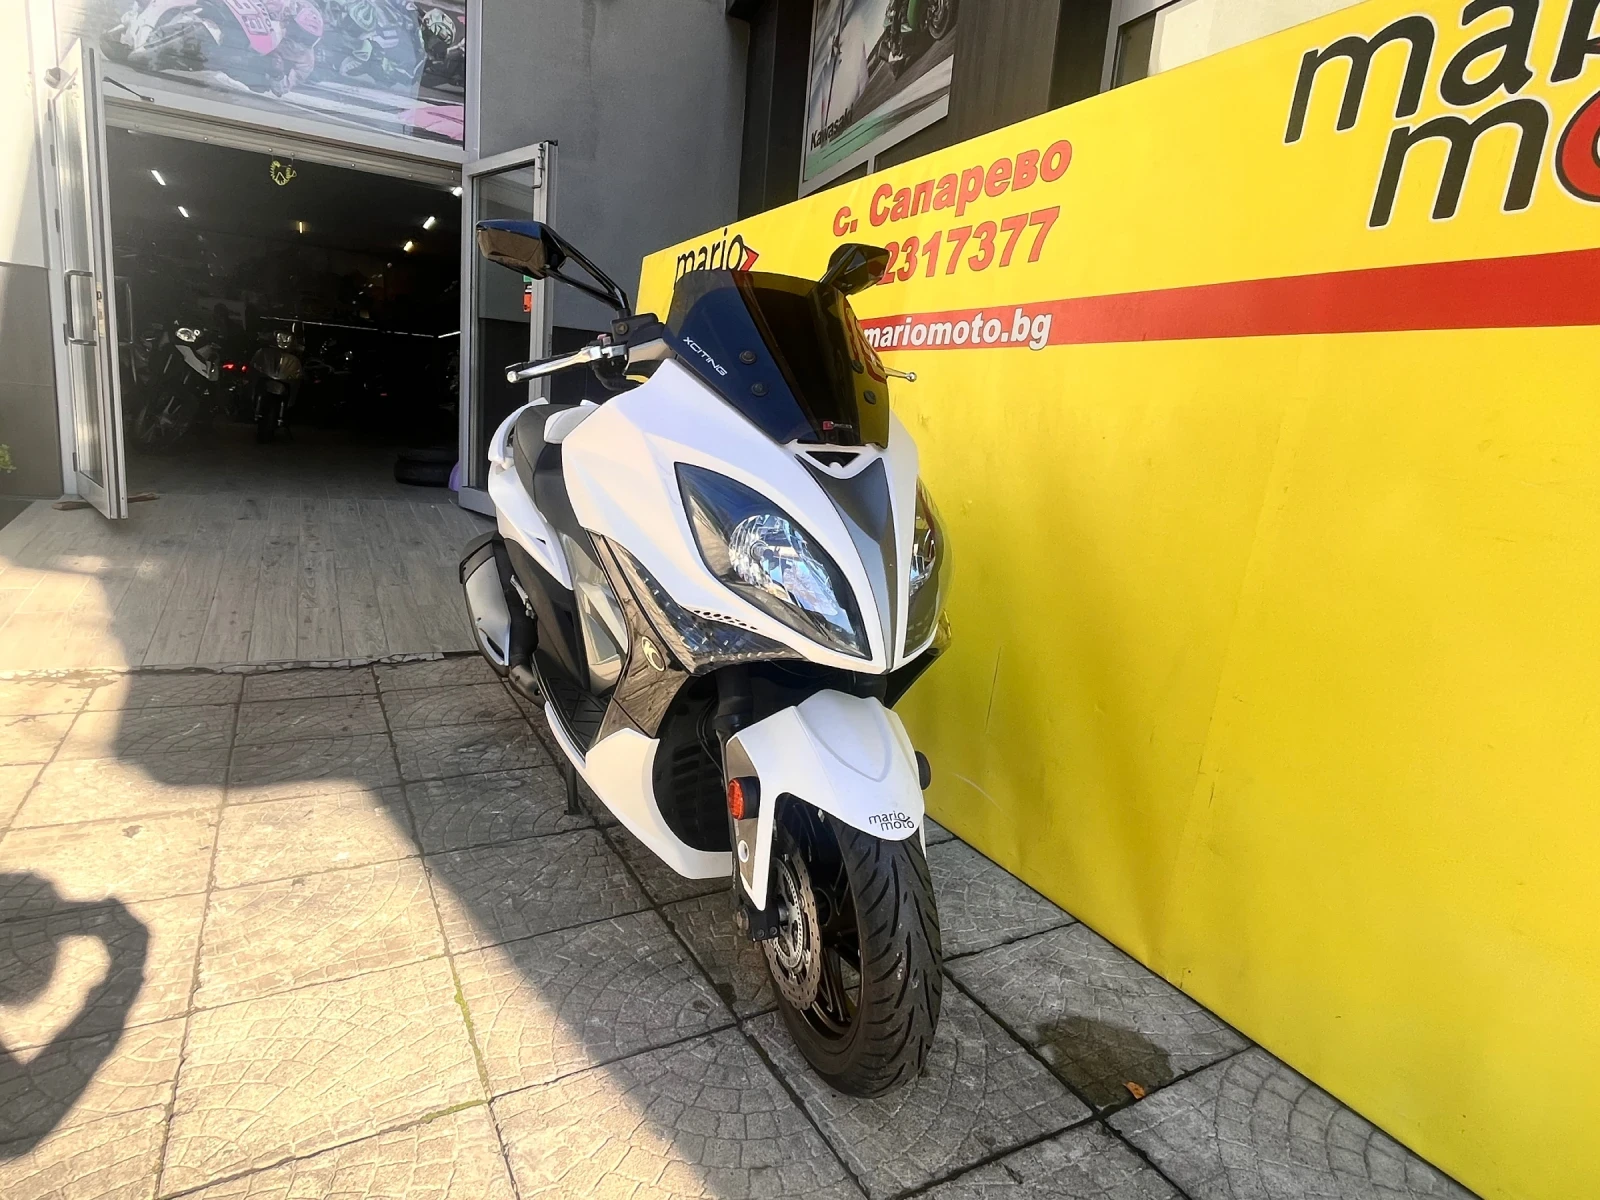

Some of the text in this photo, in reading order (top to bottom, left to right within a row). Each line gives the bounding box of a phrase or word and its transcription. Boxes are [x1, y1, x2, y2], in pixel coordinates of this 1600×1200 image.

[833, 139, 1073, 236] с. Сапарево
[675, 227, 744, 281] mario
[876, 205, 1060, 286] 2317377
[863, 308, 1052, 350] mariomoto.bg
[683, 336, 728, 376] XCITING
[868, 810, 906, 824] mario
[880, 820, 915, 831] moto
